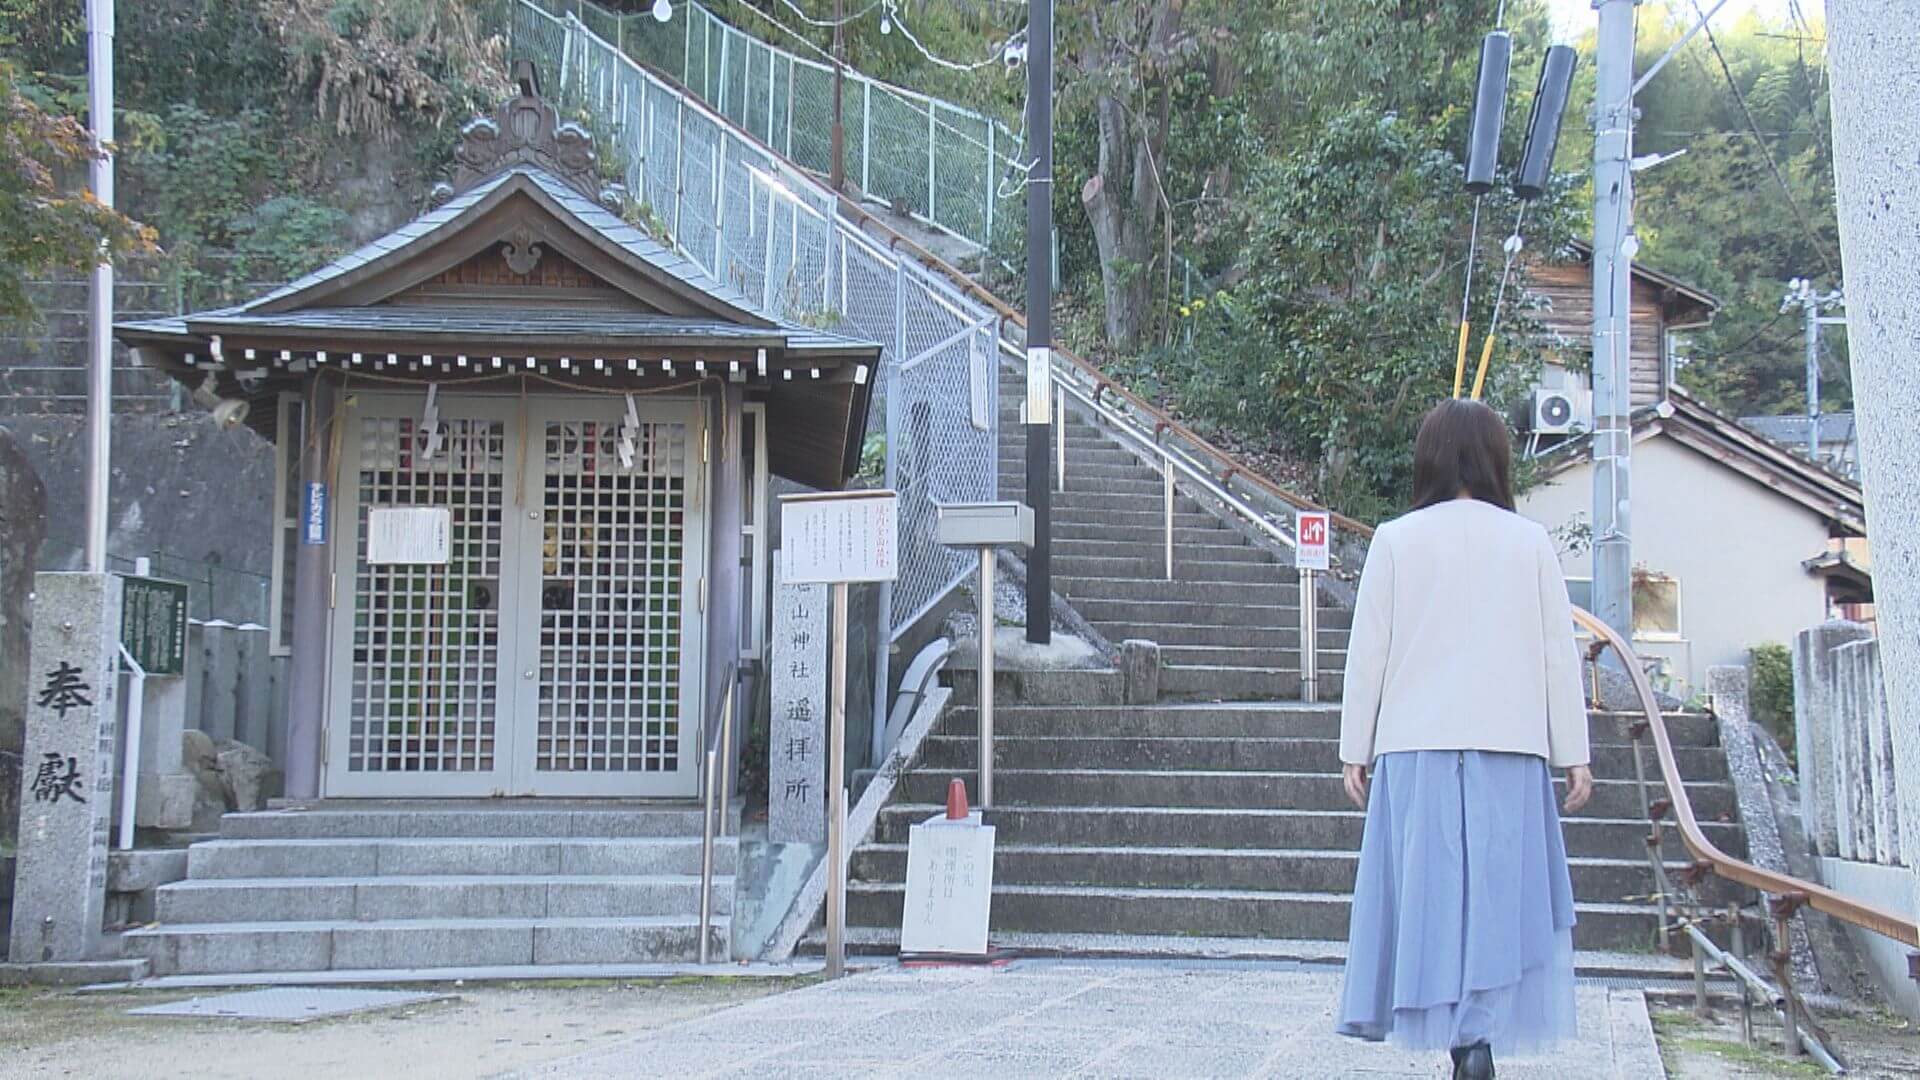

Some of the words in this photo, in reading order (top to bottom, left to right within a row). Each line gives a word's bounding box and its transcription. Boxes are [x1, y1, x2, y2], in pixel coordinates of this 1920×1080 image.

[924, 859, 939, 926] ありません
